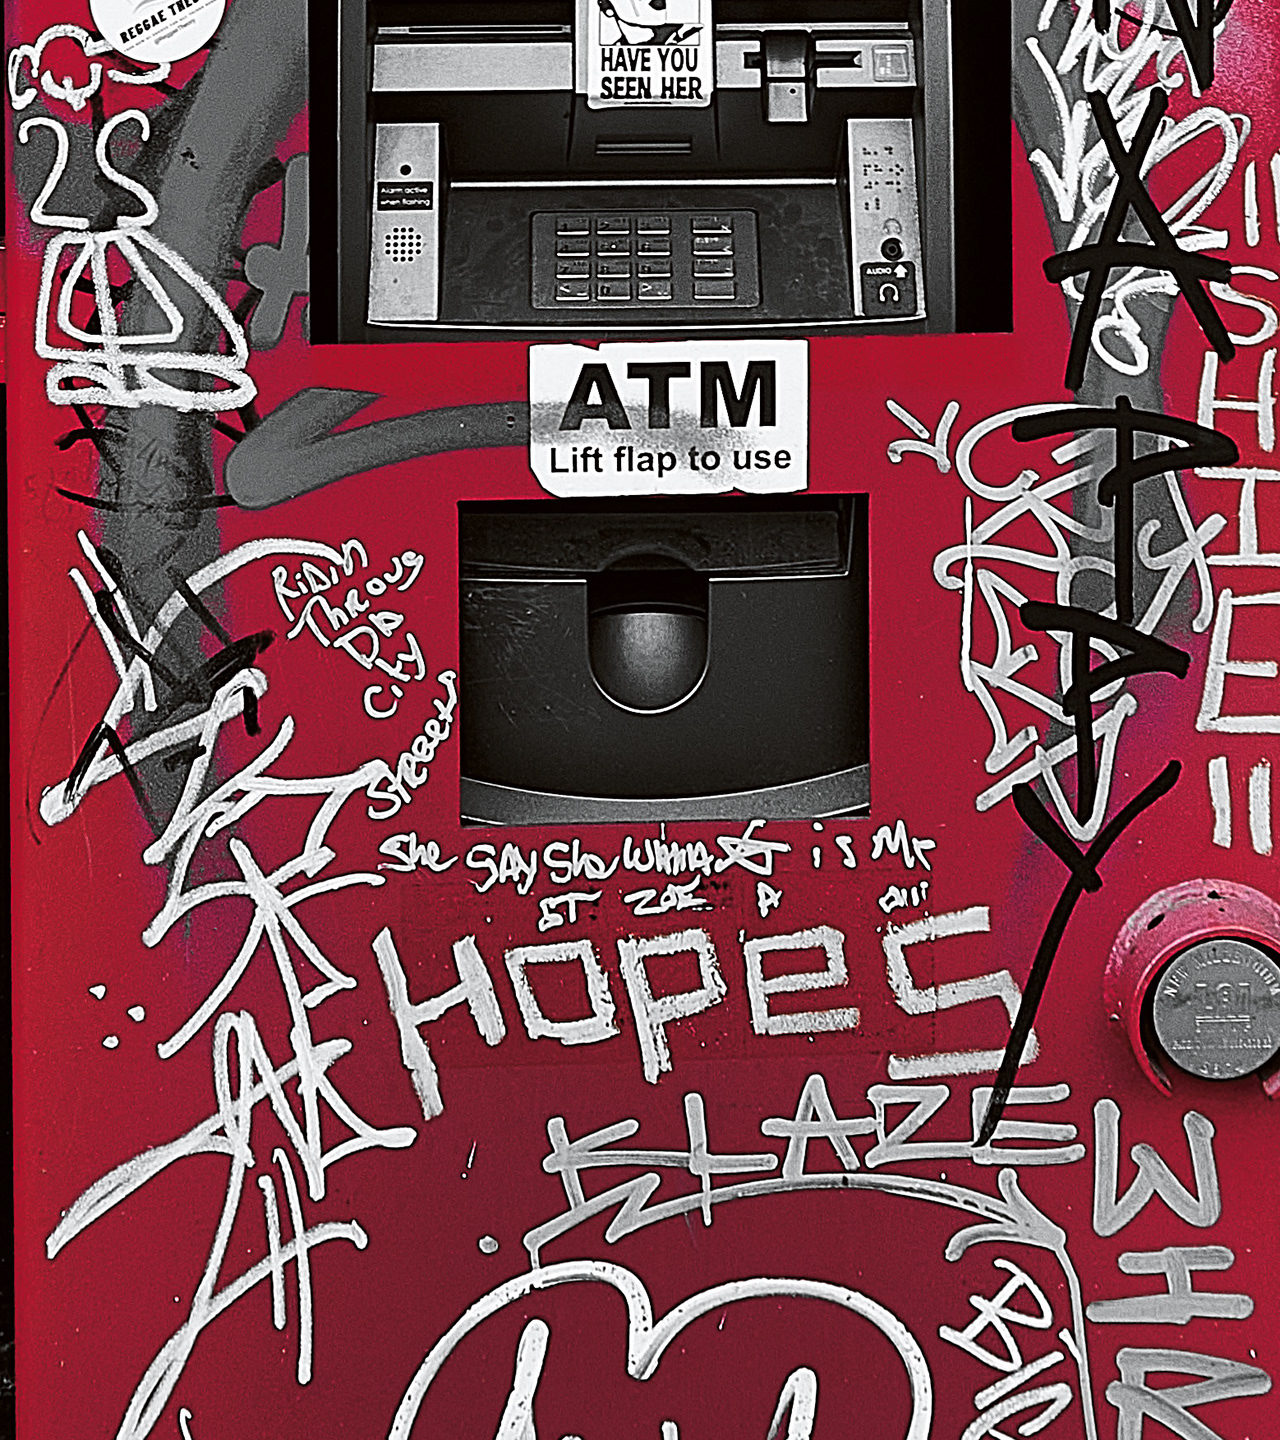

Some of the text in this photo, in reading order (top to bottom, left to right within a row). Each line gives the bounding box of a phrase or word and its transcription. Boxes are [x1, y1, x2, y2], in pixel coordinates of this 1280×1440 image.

[119, 9, 168, 45] REGGAE
[599, 46, 699, 73] HAVE YOU
[599, 75, 704, 100] SEEN HER
[558, 359, 778, 431] ATM
[549, 445, 793, 479] Lift flap to use
